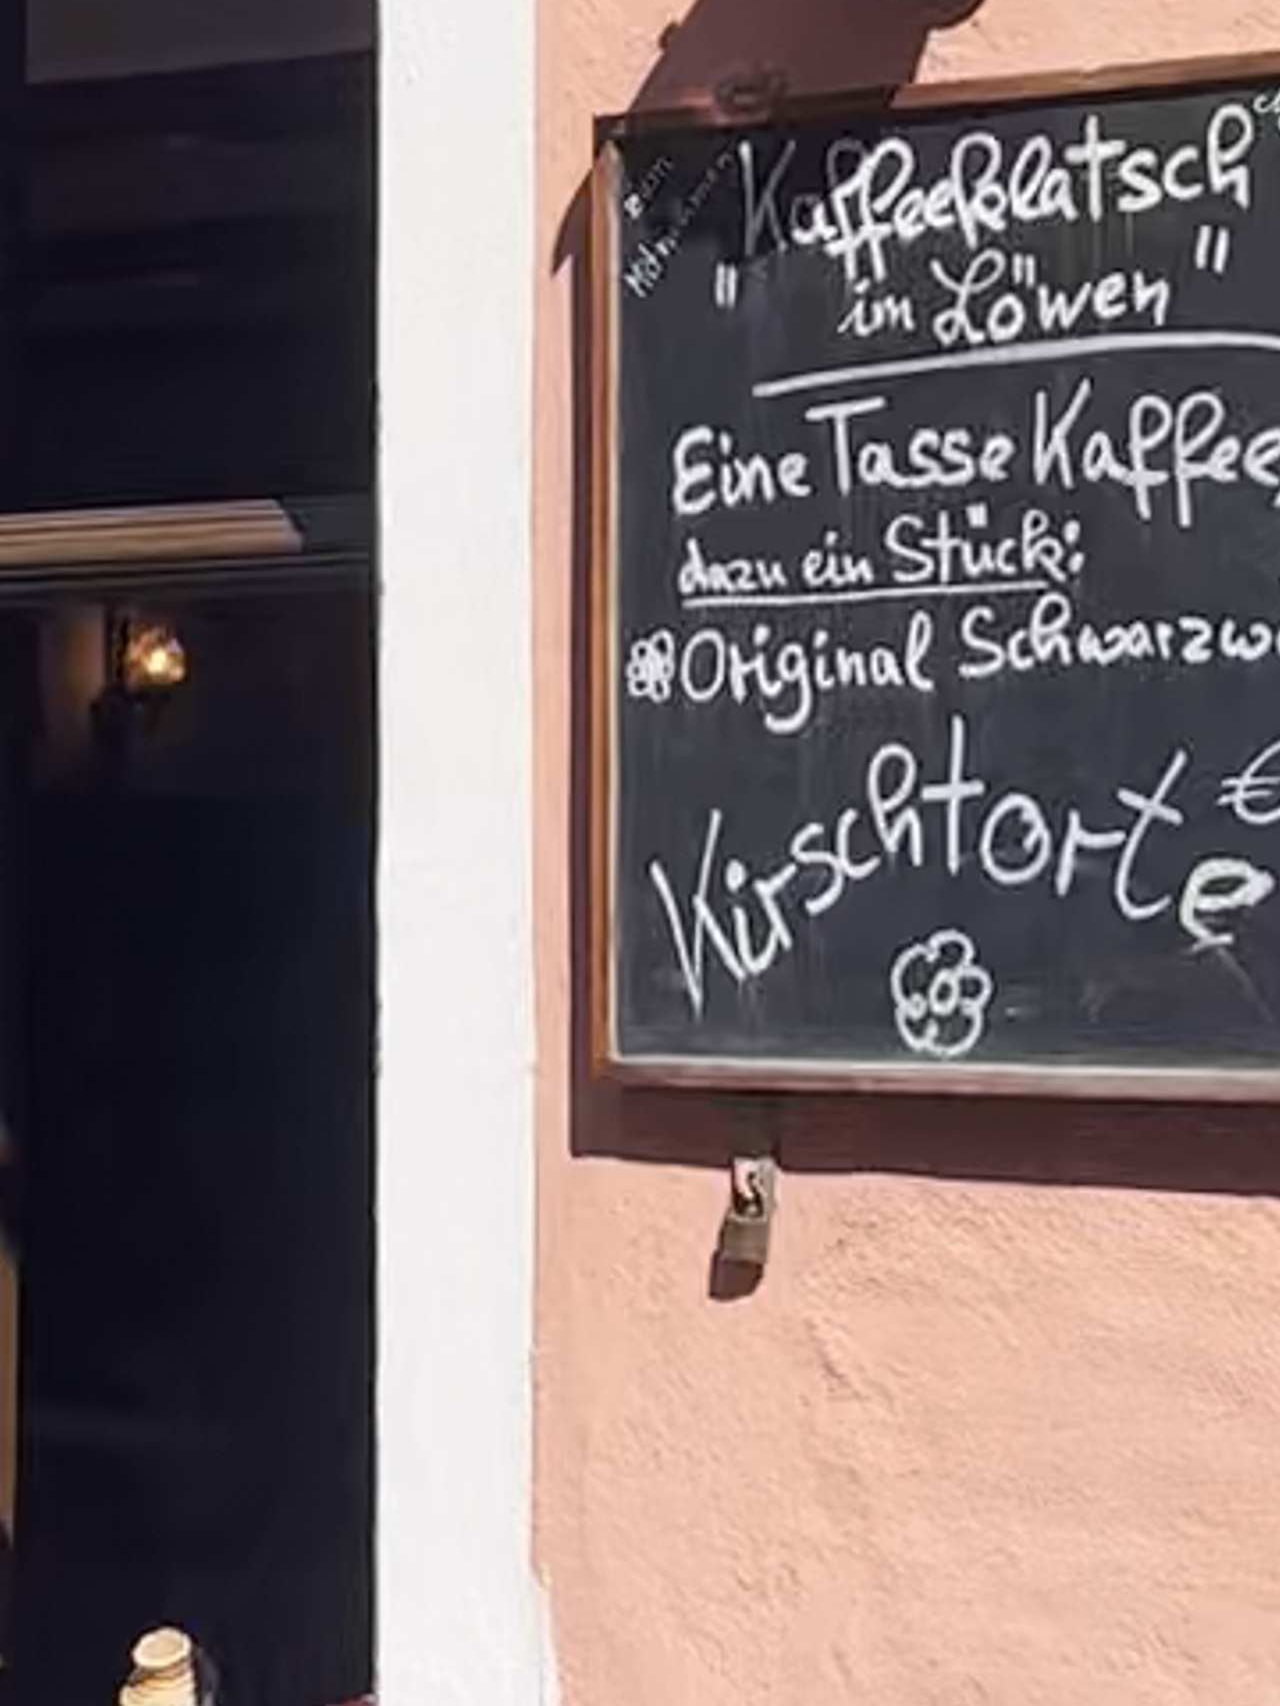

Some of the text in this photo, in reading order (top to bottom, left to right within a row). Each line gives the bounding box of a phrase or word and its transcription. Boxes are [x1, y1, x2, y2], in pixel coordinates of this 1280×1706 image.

[737, 102, 1255, 283] Kaffeeklatsch
[929, 248, 1171, 346] Löwen
[673, 424, 812, 515] Eine
[805, 396, 1011, 493] Tasse
[677, 502, 1086, 594] dazu ein Stück:
[681, 610, 936, 735] Original
[650, 715, 1277, 1019] Kirschtorte
